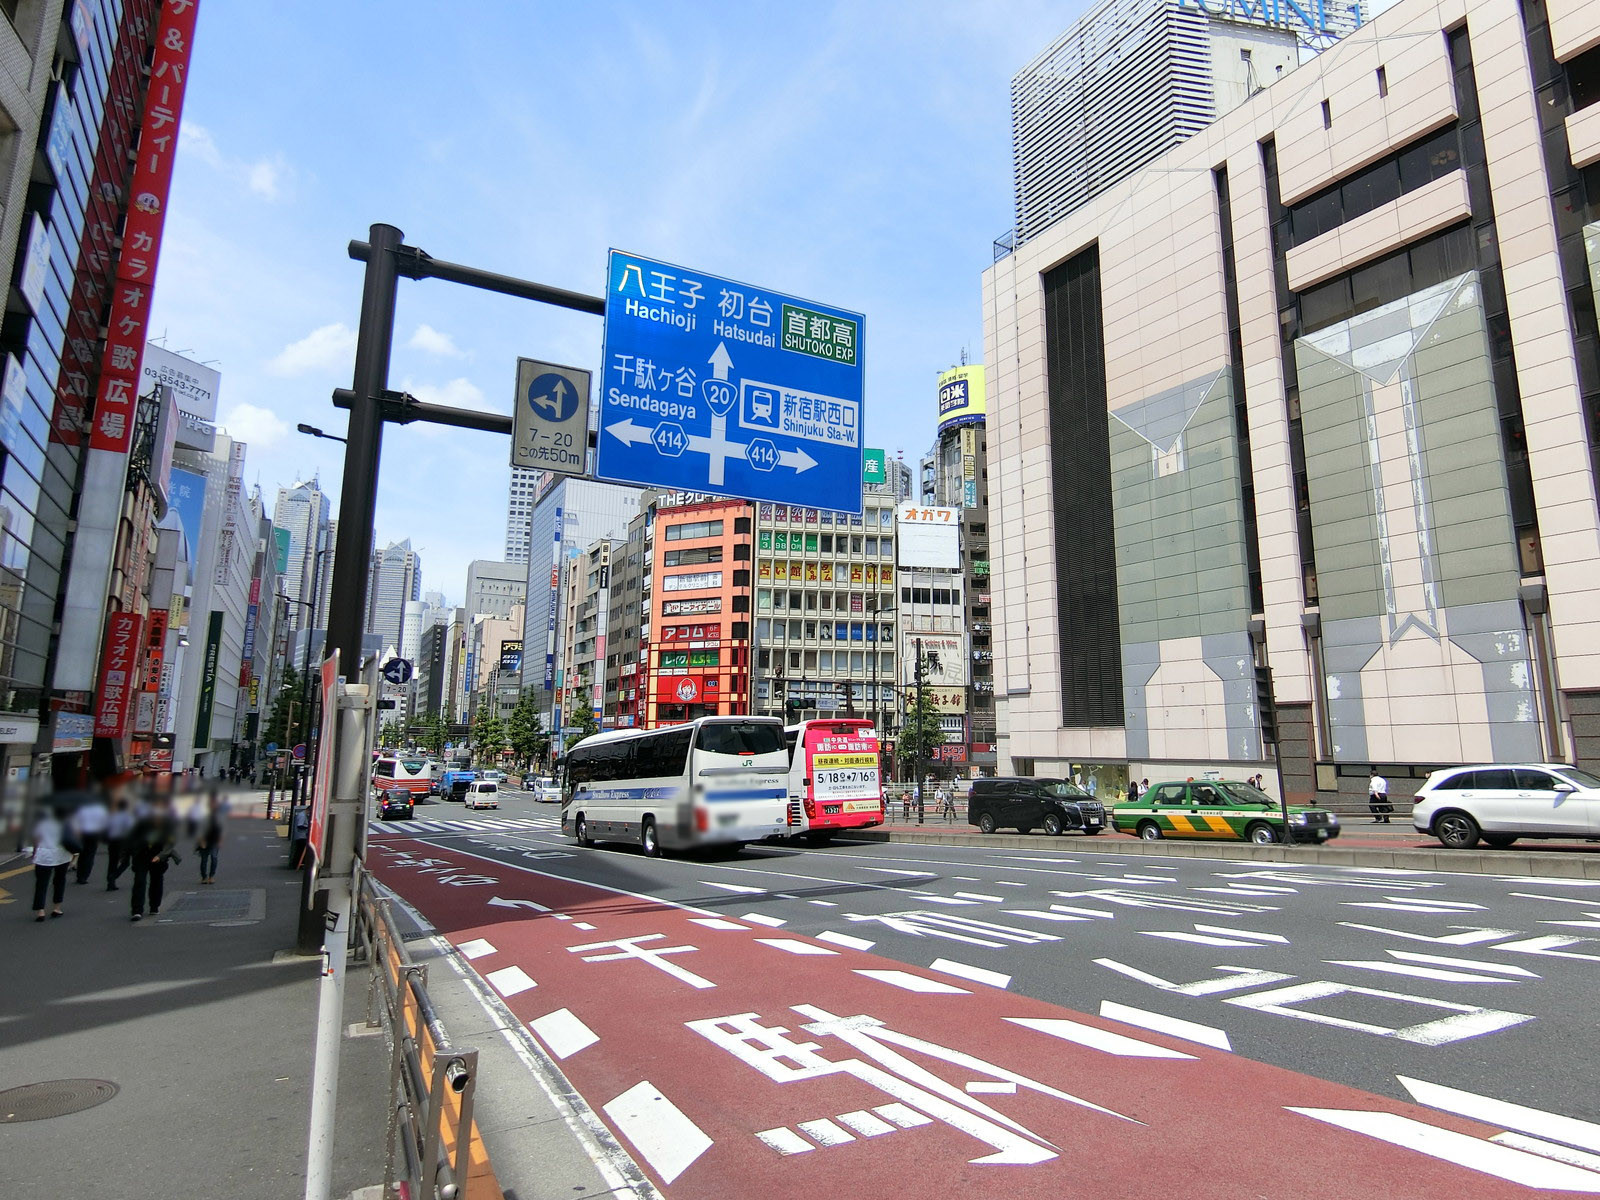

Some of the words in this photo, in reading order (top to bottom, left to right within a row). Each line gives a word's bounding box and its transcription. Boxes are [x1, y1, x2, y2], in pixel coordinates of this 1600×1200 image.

[618, 264, 706, 309] 八王子
[717, 288, 774, 328] 初台
[625, 298, 697, 332] Hachioji
[713, 319, 776, 348] Hatsudai
[787, 310, 853, 347] 首都高
[100, 231, 153, 440] カラオケ歌広場
[785, 334, 833, 356] SHUTOKO
[835, 345, 854, 361] EXP
[144, 367, 211, 400] 03-3543-7771
[613, 354, 697, 398] 千駄ヶ谷
[608, 388, 696, 420] Sendagaya
[709, 385, 730, 405] 20
[783, 392, 855, 427] 新宿駅西口
[186, 420, 211, 435] FPG
[783, 419, 824, 437] Shinjuku
[656, 430, 683, 449] 414
[519, 446, 580, 465] この先50m
[751, 445, 775, 463] 414
[905, 508, 951, 522] オガワ
[761, 532, 800, 542] ほぐし
[759, 564, 802, 577] 占い館
[851, 567, 892, 581] 占い館
[664, 626, 704, 640] アコム
[111, 618, 134, 669] カラオケ
[99, 686, 123, 727] 歌広場
[906, 692, 962, 707] 老餃子館
[742, 759, 753, 767] JR
[817, 772, 839, 784] 5/18
[851, 771, 870, 782] 7/16
[592, 790, 610, 799] Swallow
[611, 790, 630, 800] Express
